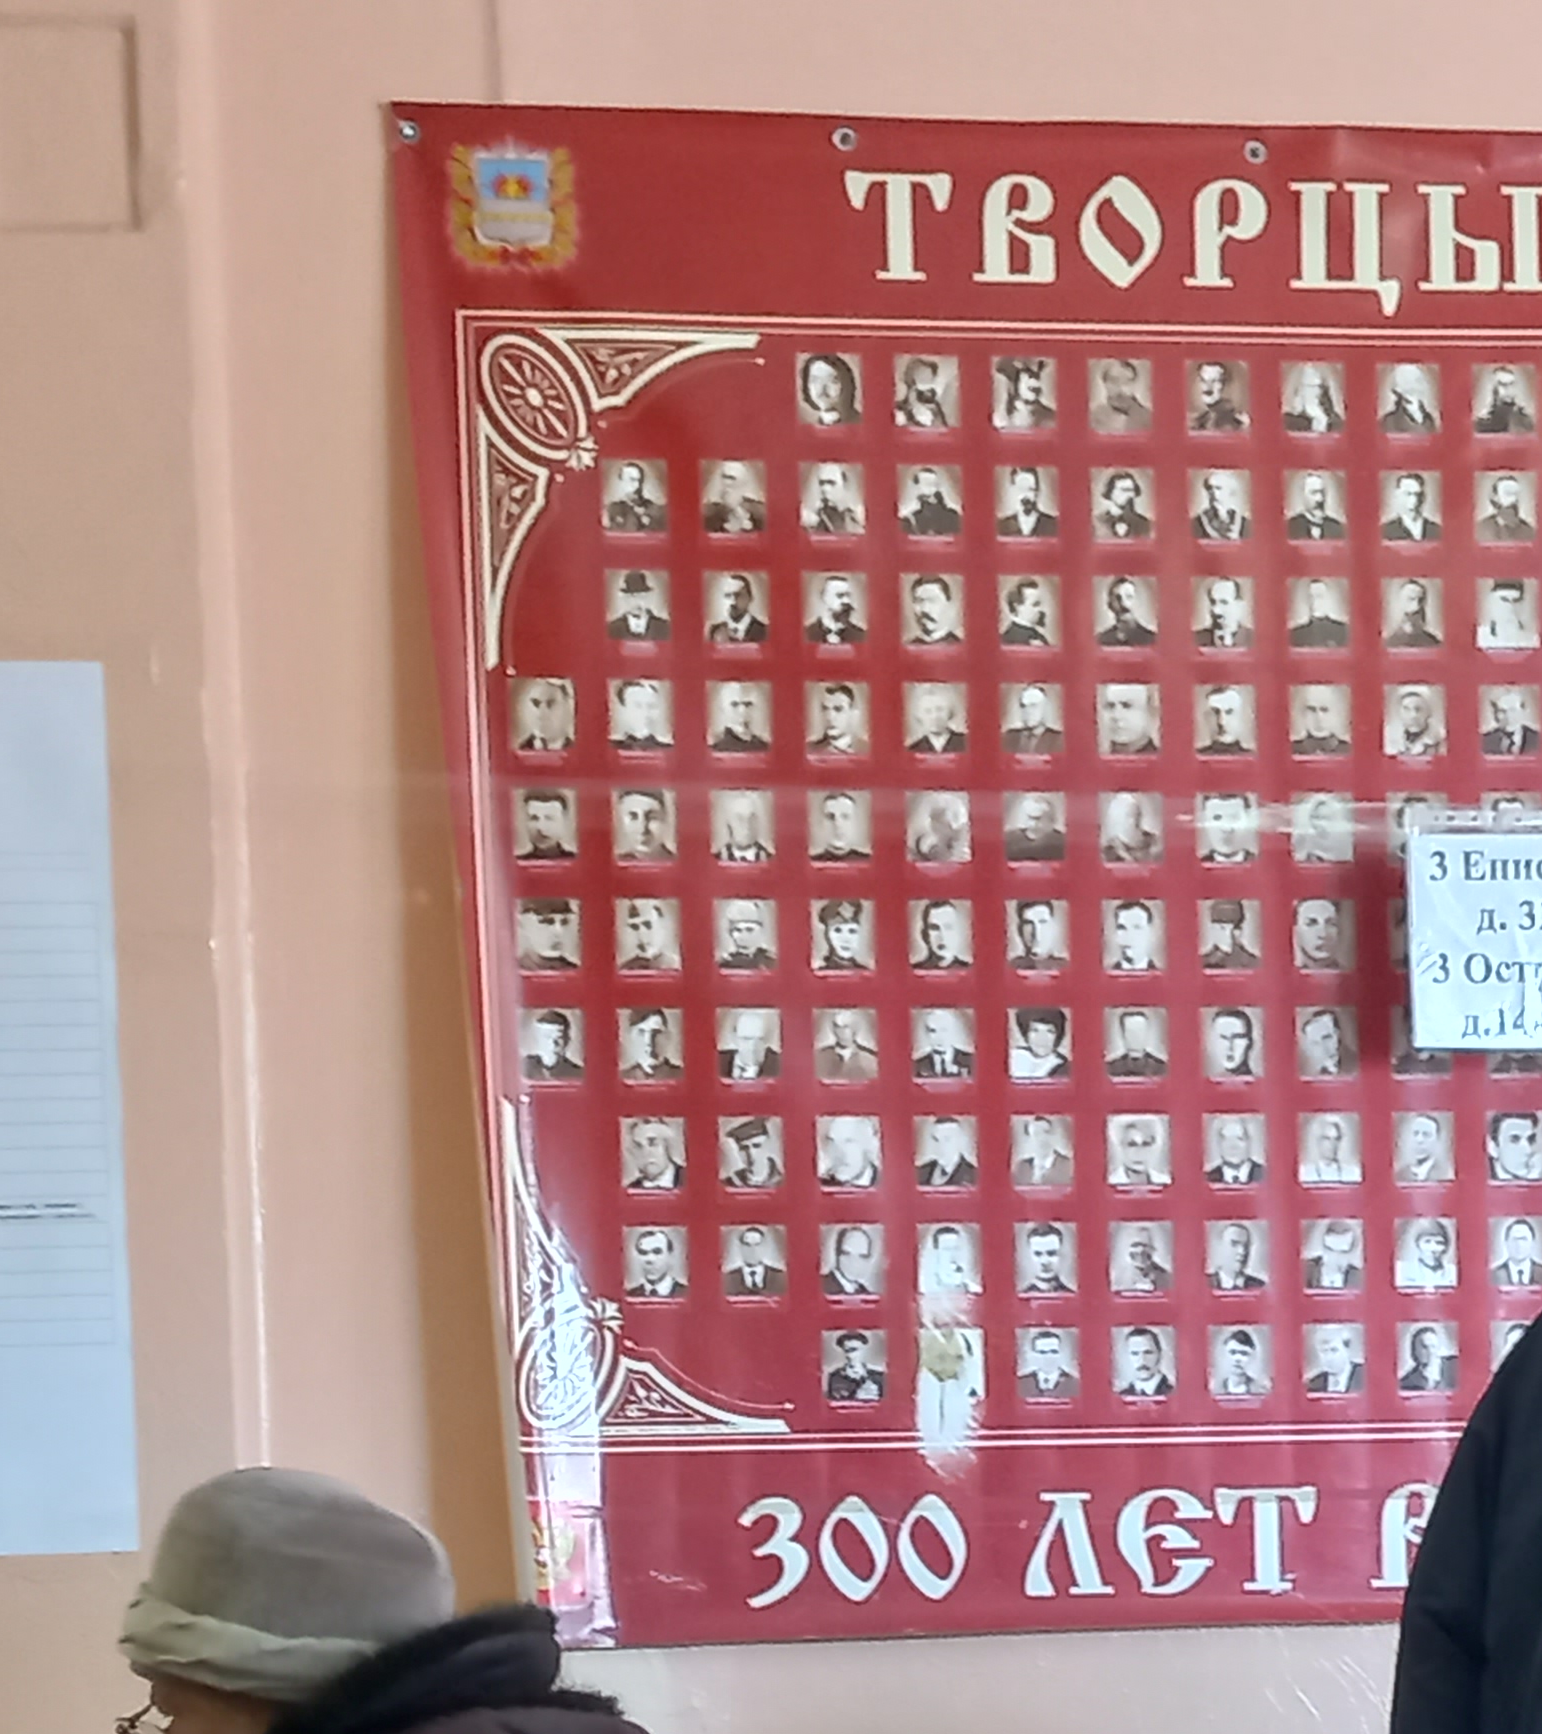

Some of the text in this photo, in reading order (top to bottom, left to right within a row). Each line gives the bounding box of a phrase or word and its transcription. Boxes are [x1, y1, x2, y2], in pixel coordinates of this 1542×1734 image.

[1428, 850, 1449, 882] 3
[1476, 907, 1508, 935] д.
[1431, 952, 1450, 984] 3
[737, 1492, 969, 1608] 300
[1023, 1485, 1319, 1597] ЛЕТ
